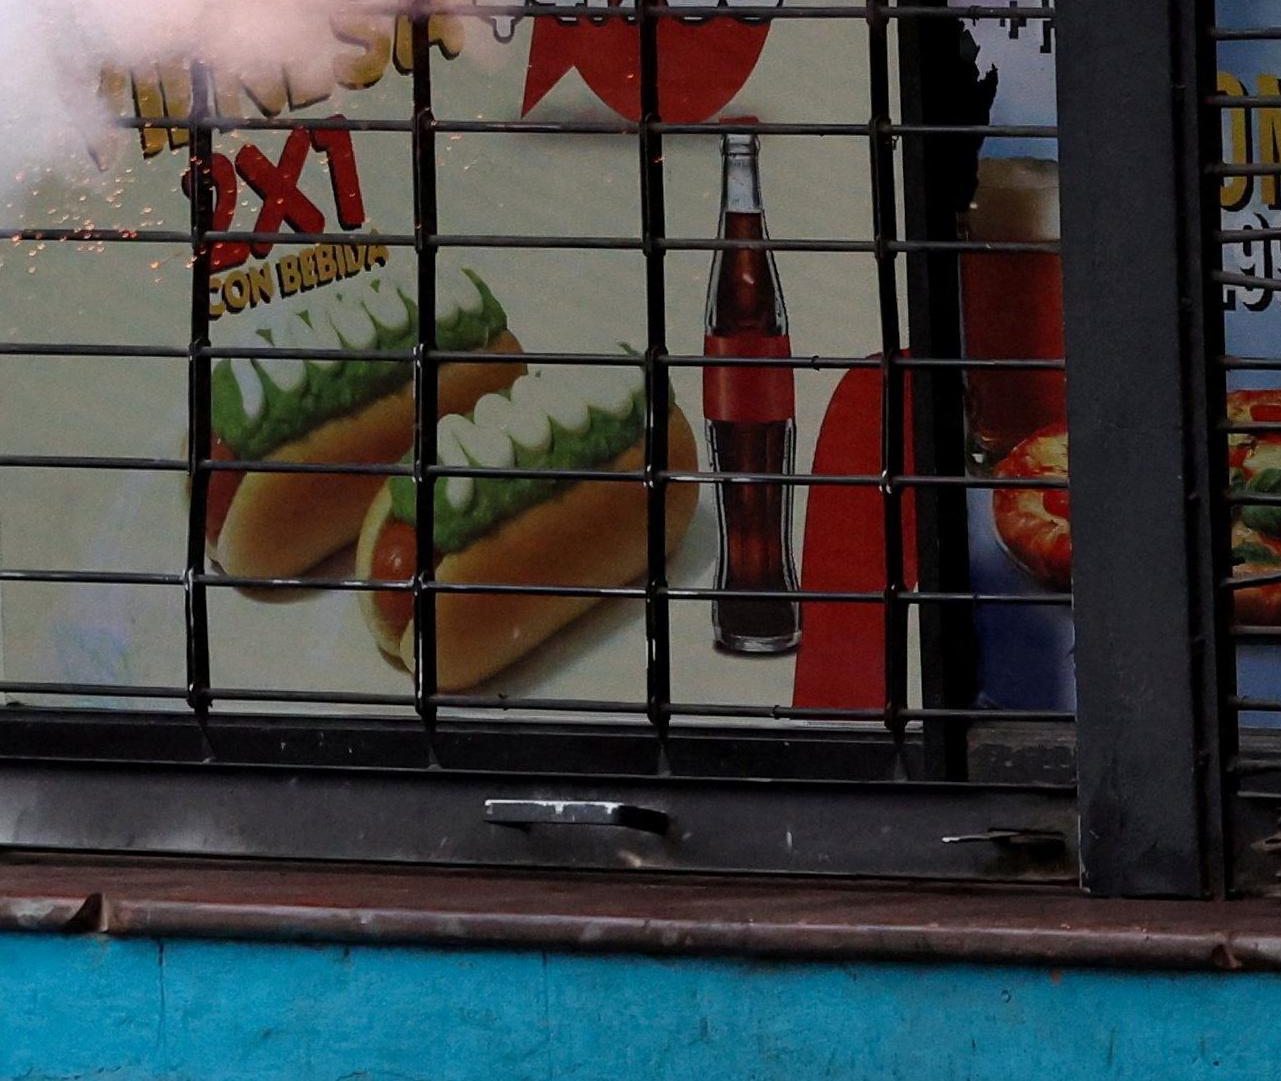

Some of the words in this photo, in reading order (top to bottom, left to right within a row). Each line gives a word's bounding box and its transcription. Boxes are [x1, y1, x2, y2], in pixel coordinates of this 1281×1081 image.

[181, 114, 365, 274] 2X1
[202, 260, 275, 320] CON
[275, 228, 389, 299] BEBIDA
